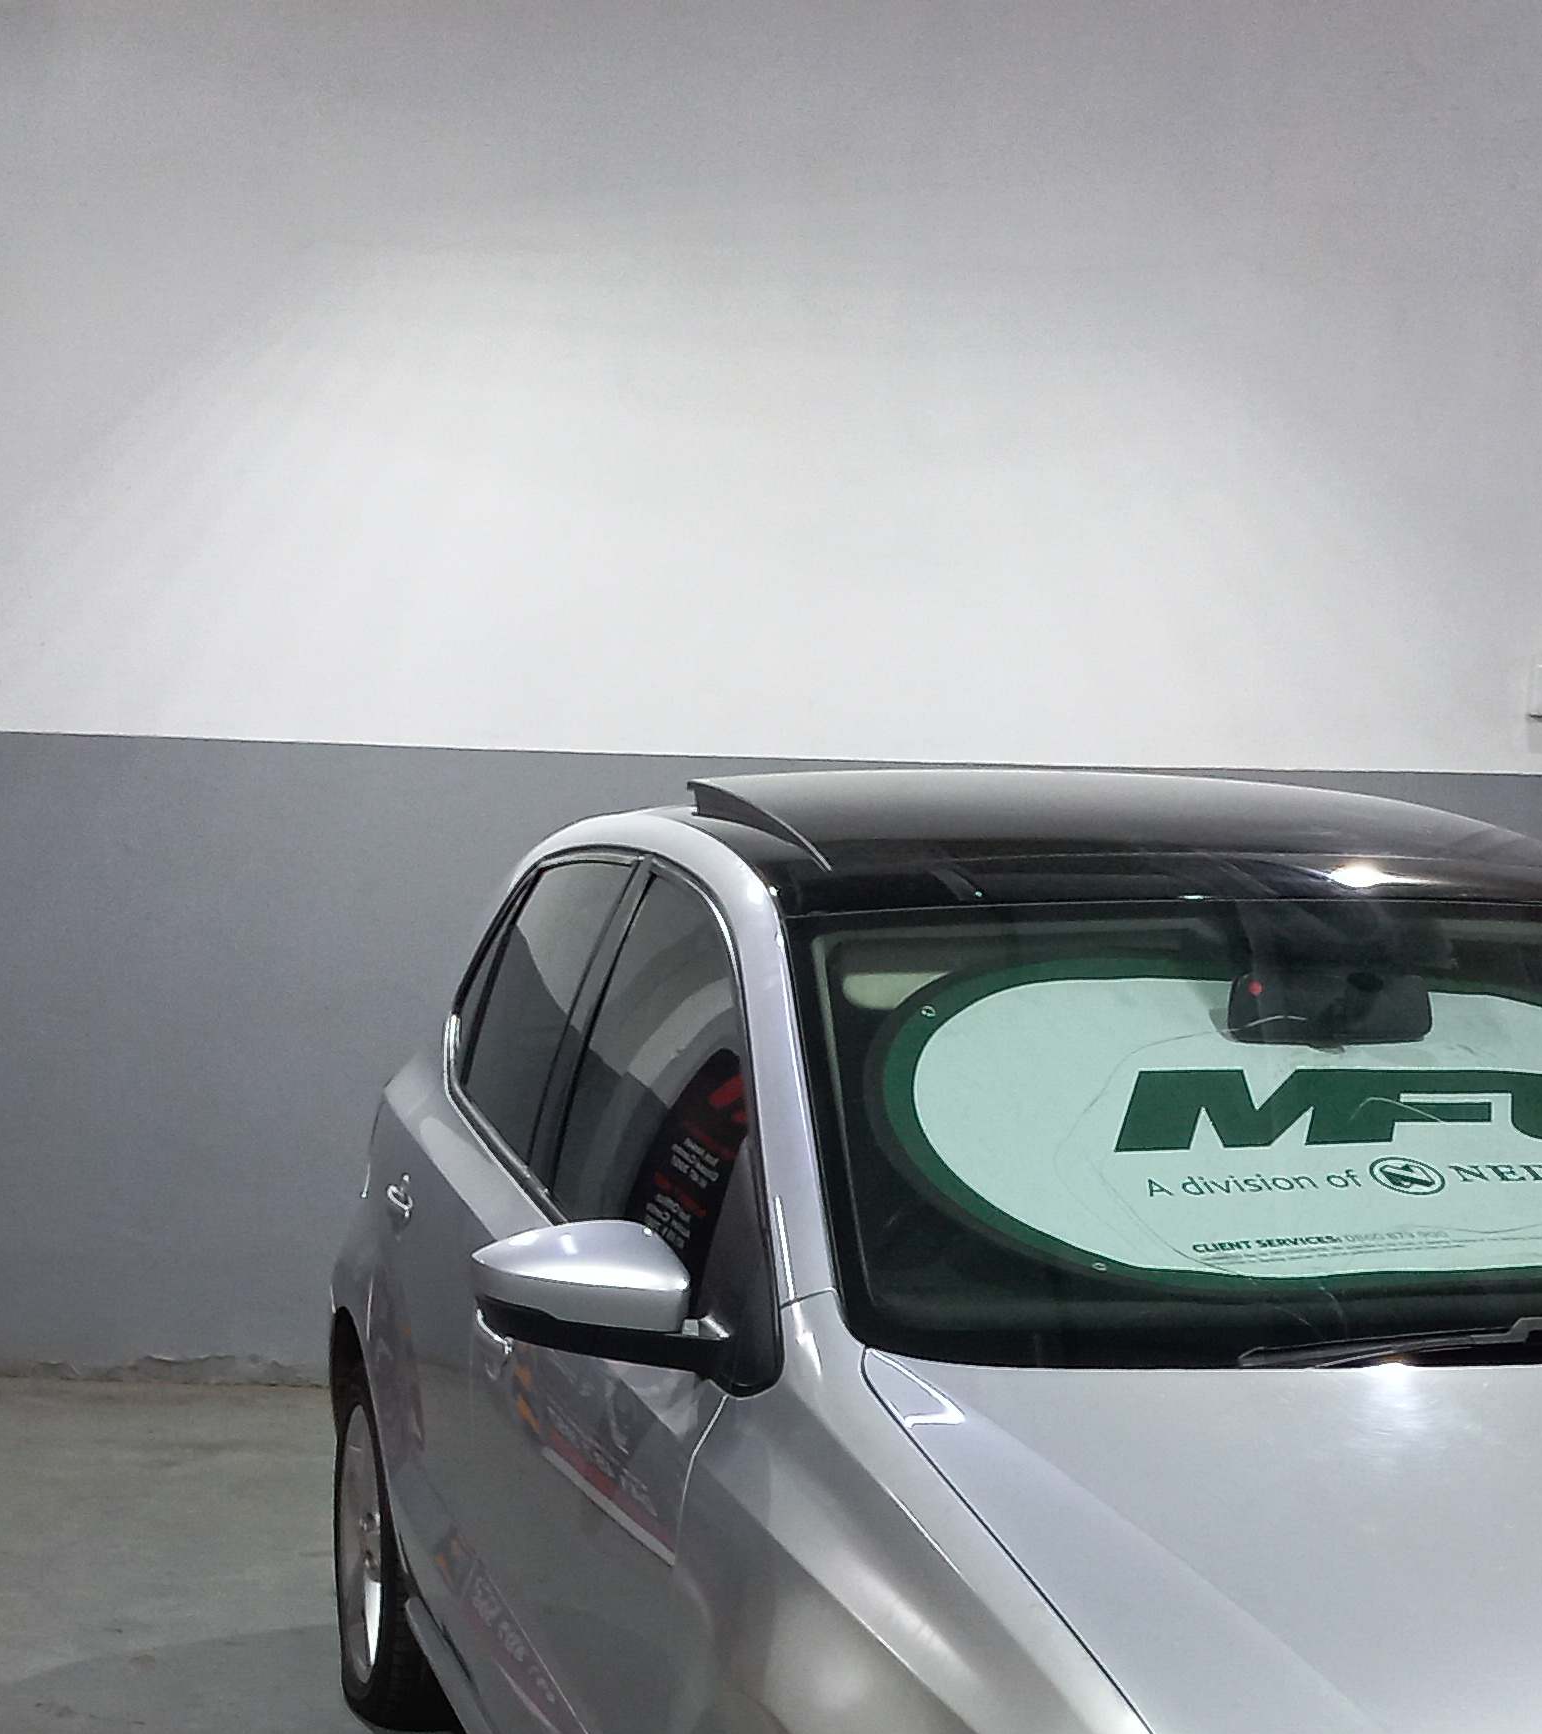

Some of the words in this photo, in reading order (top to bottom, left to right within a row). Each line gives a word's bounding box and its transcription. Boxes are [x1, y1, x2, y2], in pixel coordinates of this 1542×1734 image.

[1147, 1177, 1174, 1198] A
[1181, 1173, 1320, 1196] division
[1326, 1168, 1362, 1189] of
[1192, 1239, 1252, 1254] CLIENT
